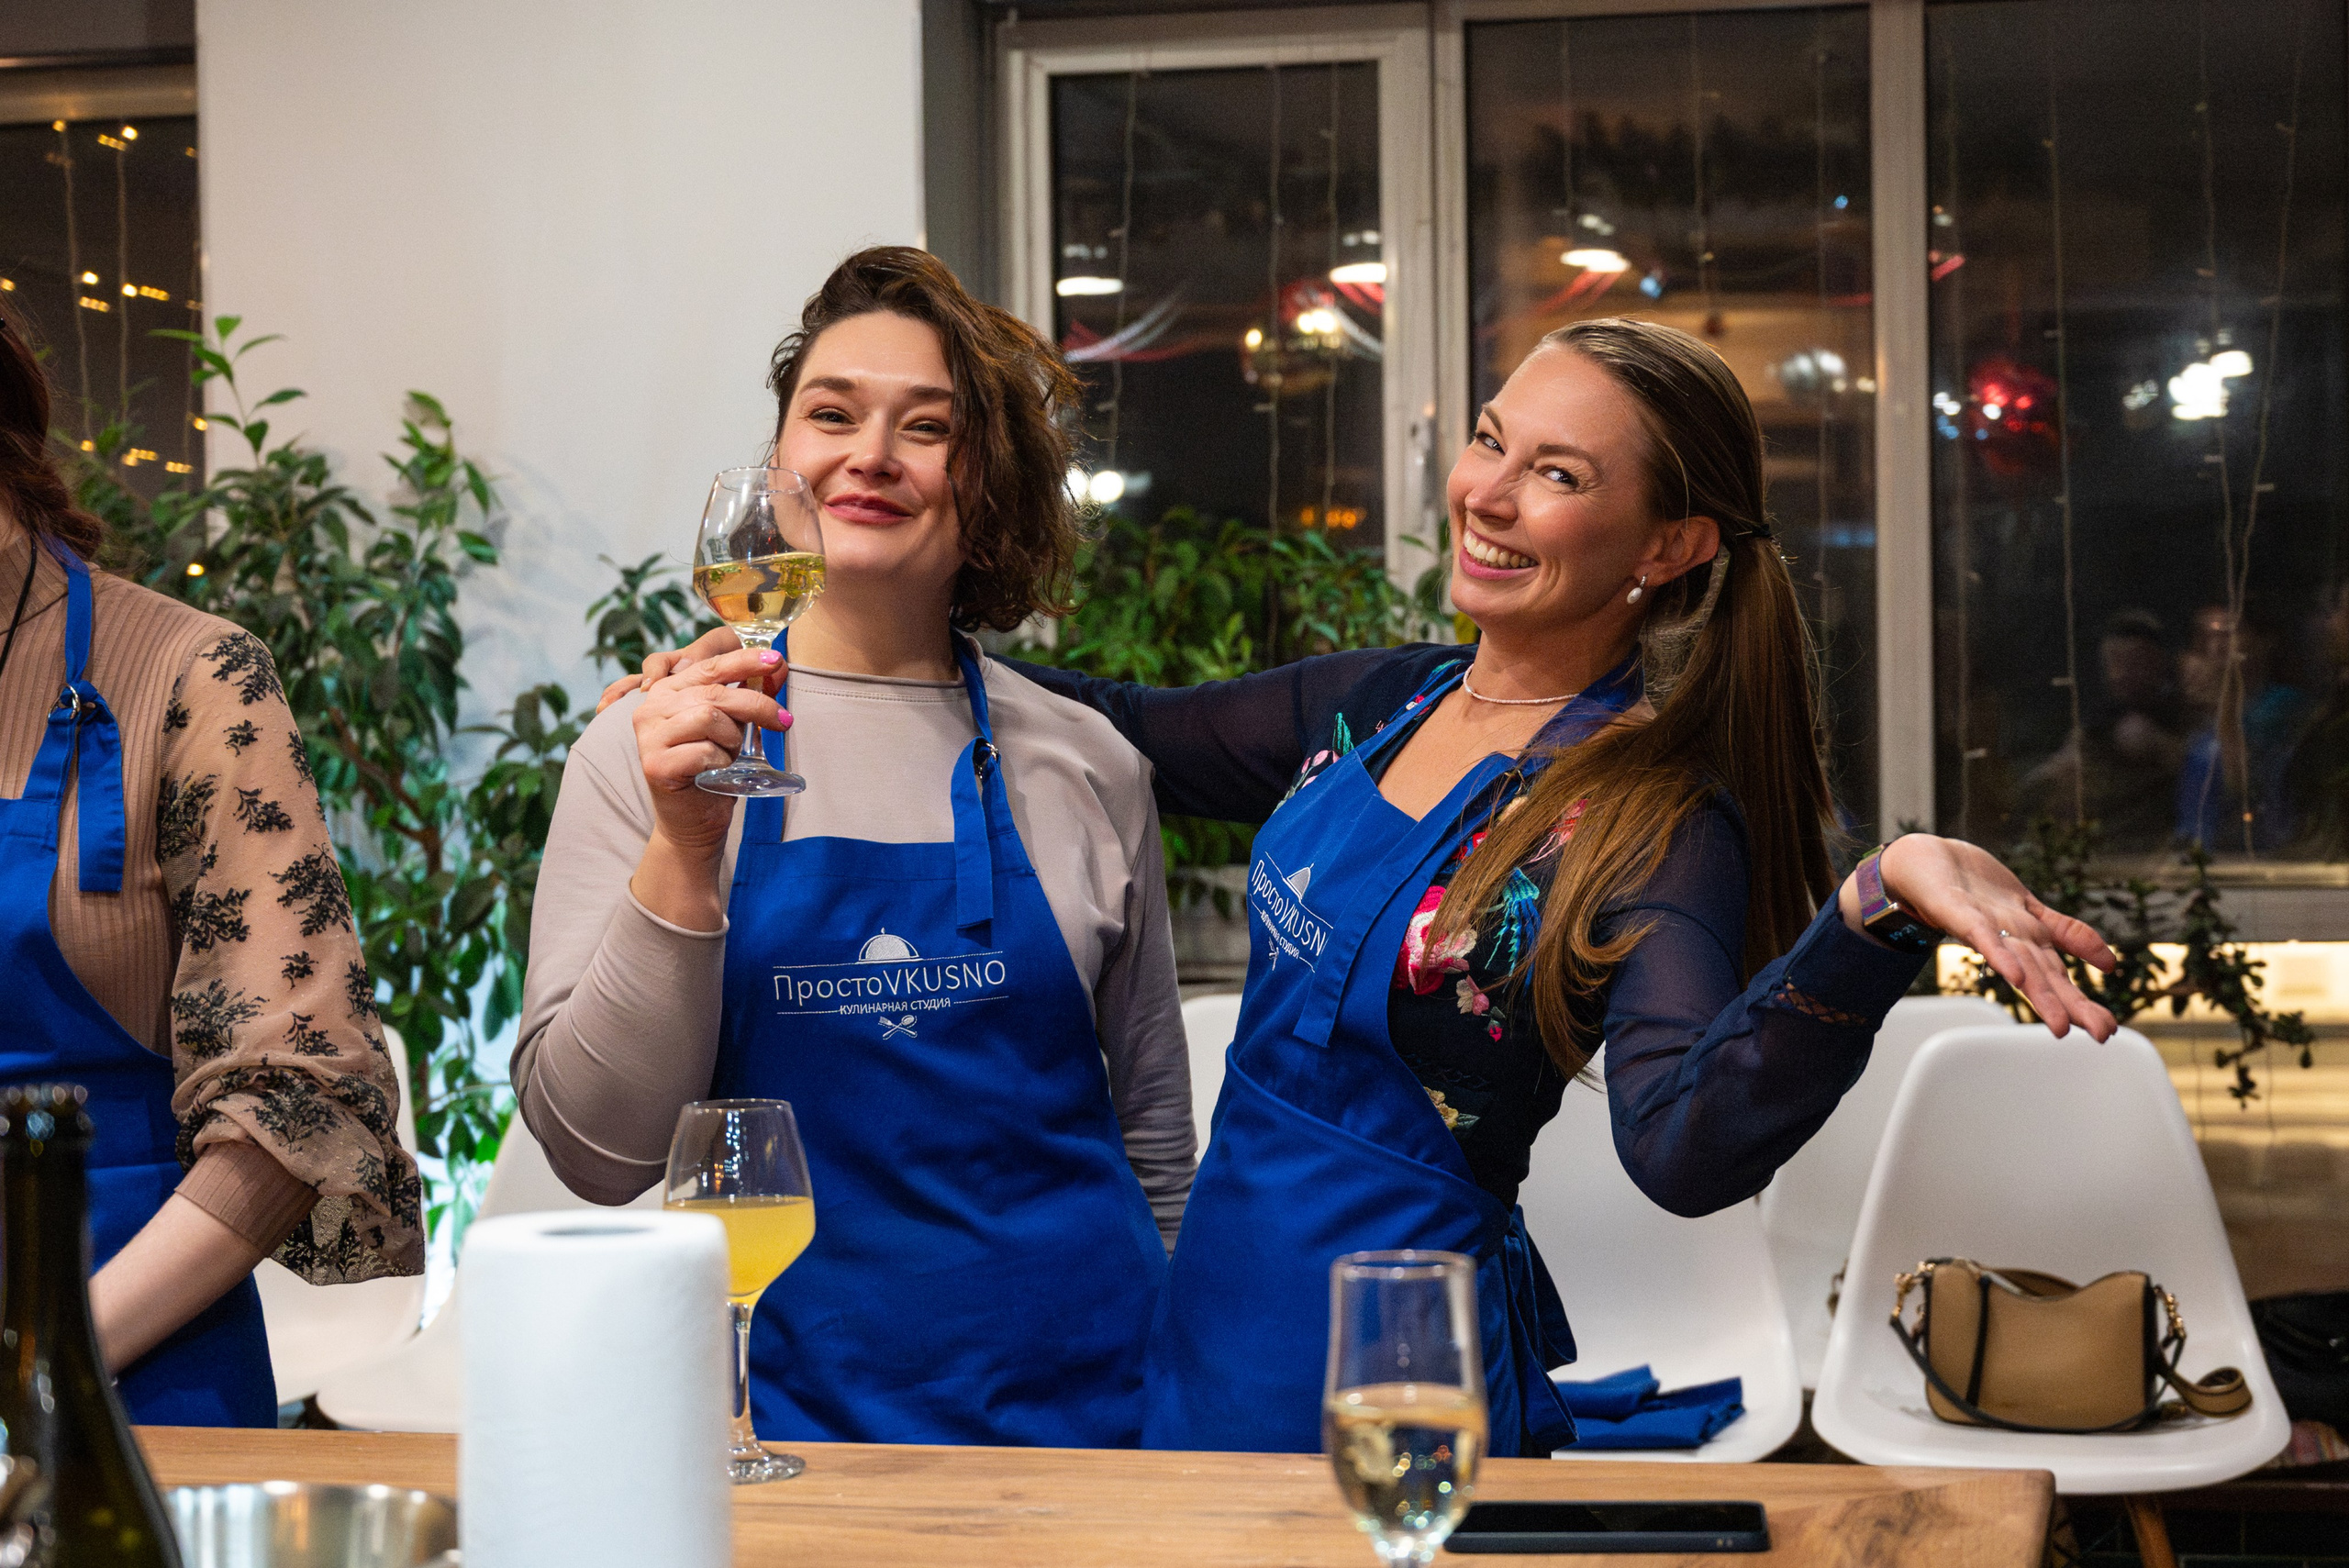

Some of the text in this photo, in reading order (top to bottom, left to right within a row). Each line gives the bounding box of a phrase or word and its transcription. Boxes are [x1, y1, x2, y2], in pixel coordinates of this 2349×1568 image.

[1252, 860, 1327, 956] ПростоVKUSN
[774, 960, 1006, 1006] ПростоVKUSNO
[840, 997, 951, 1015] КУЛИНАРНАЯ СТУДИЯ
